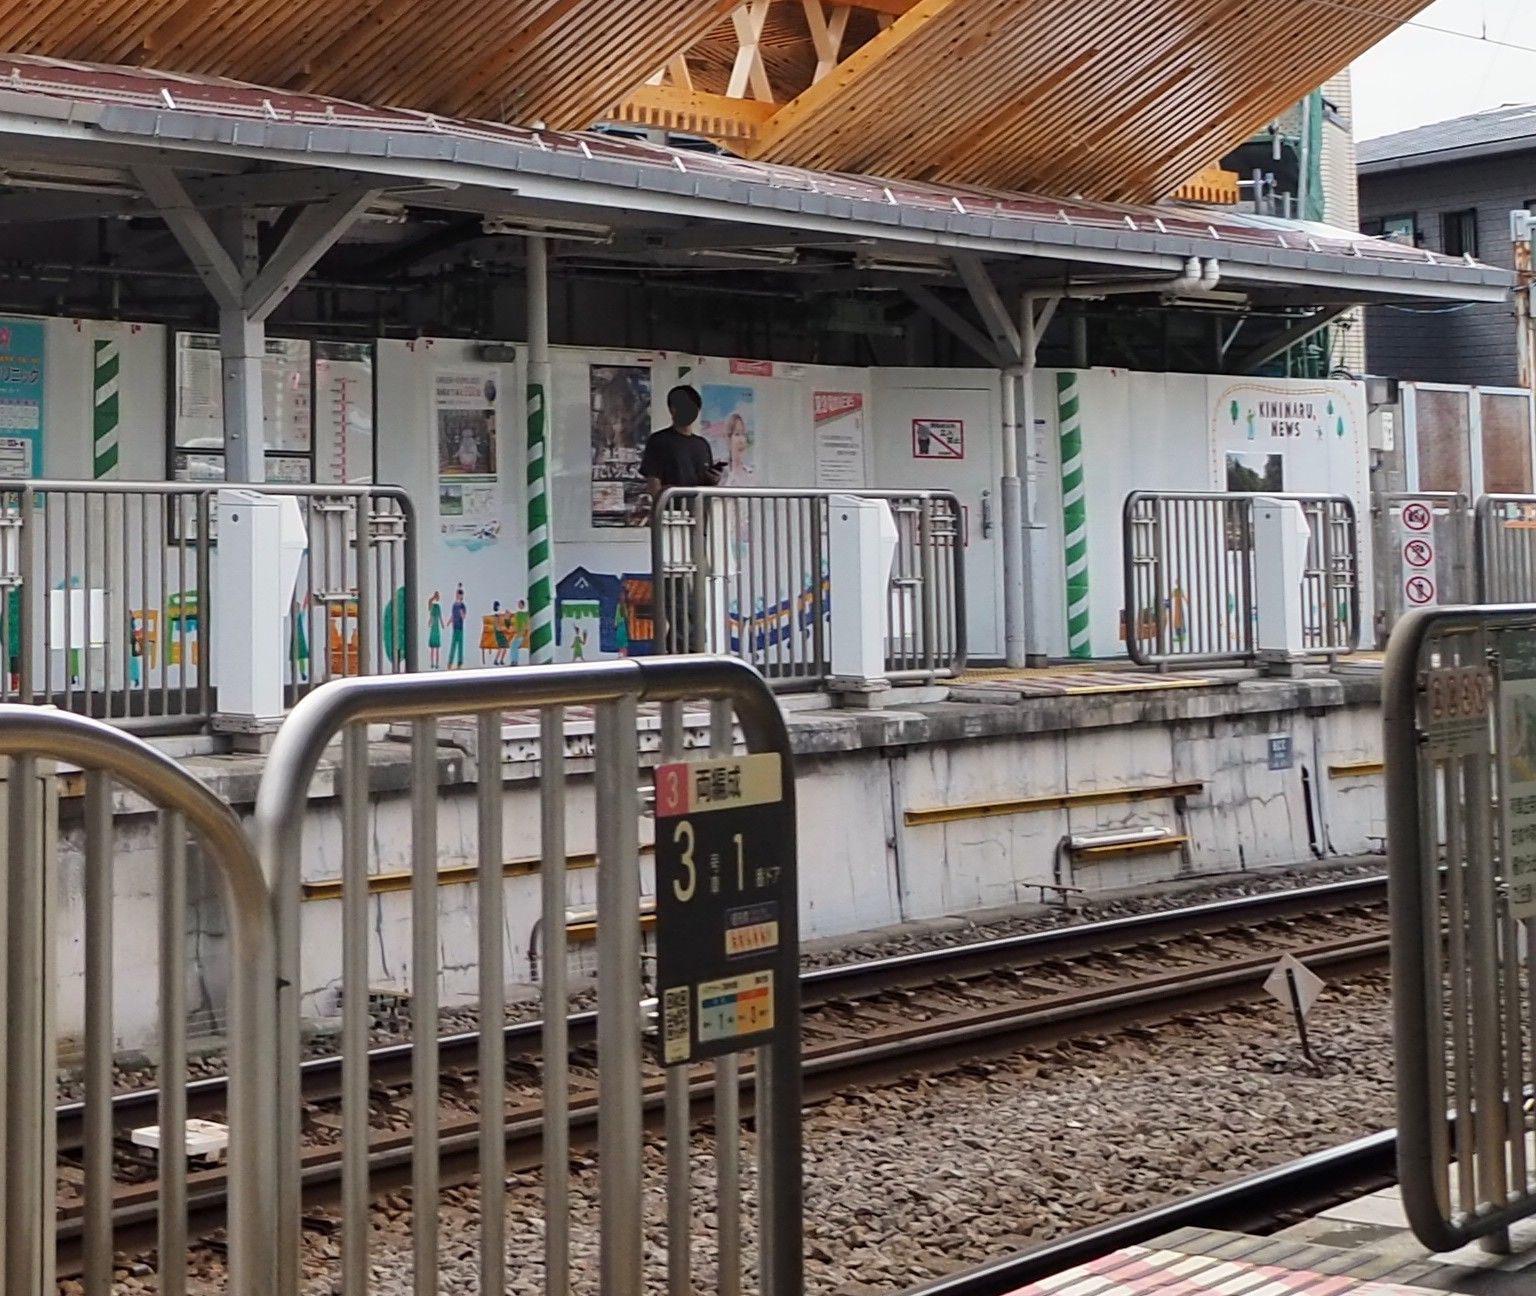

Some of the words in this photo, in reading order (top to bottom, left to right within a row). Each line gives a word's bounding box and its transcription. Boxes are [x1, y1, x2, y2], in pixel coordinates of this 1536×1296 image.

[1271, 421, 1301, 437] NEWS
[667, 771, 678, 809] 3
[695, 764, 742, 803] 両編成
[673, 820, 697, 902] 3
[733, 832, 744, 892] 1
